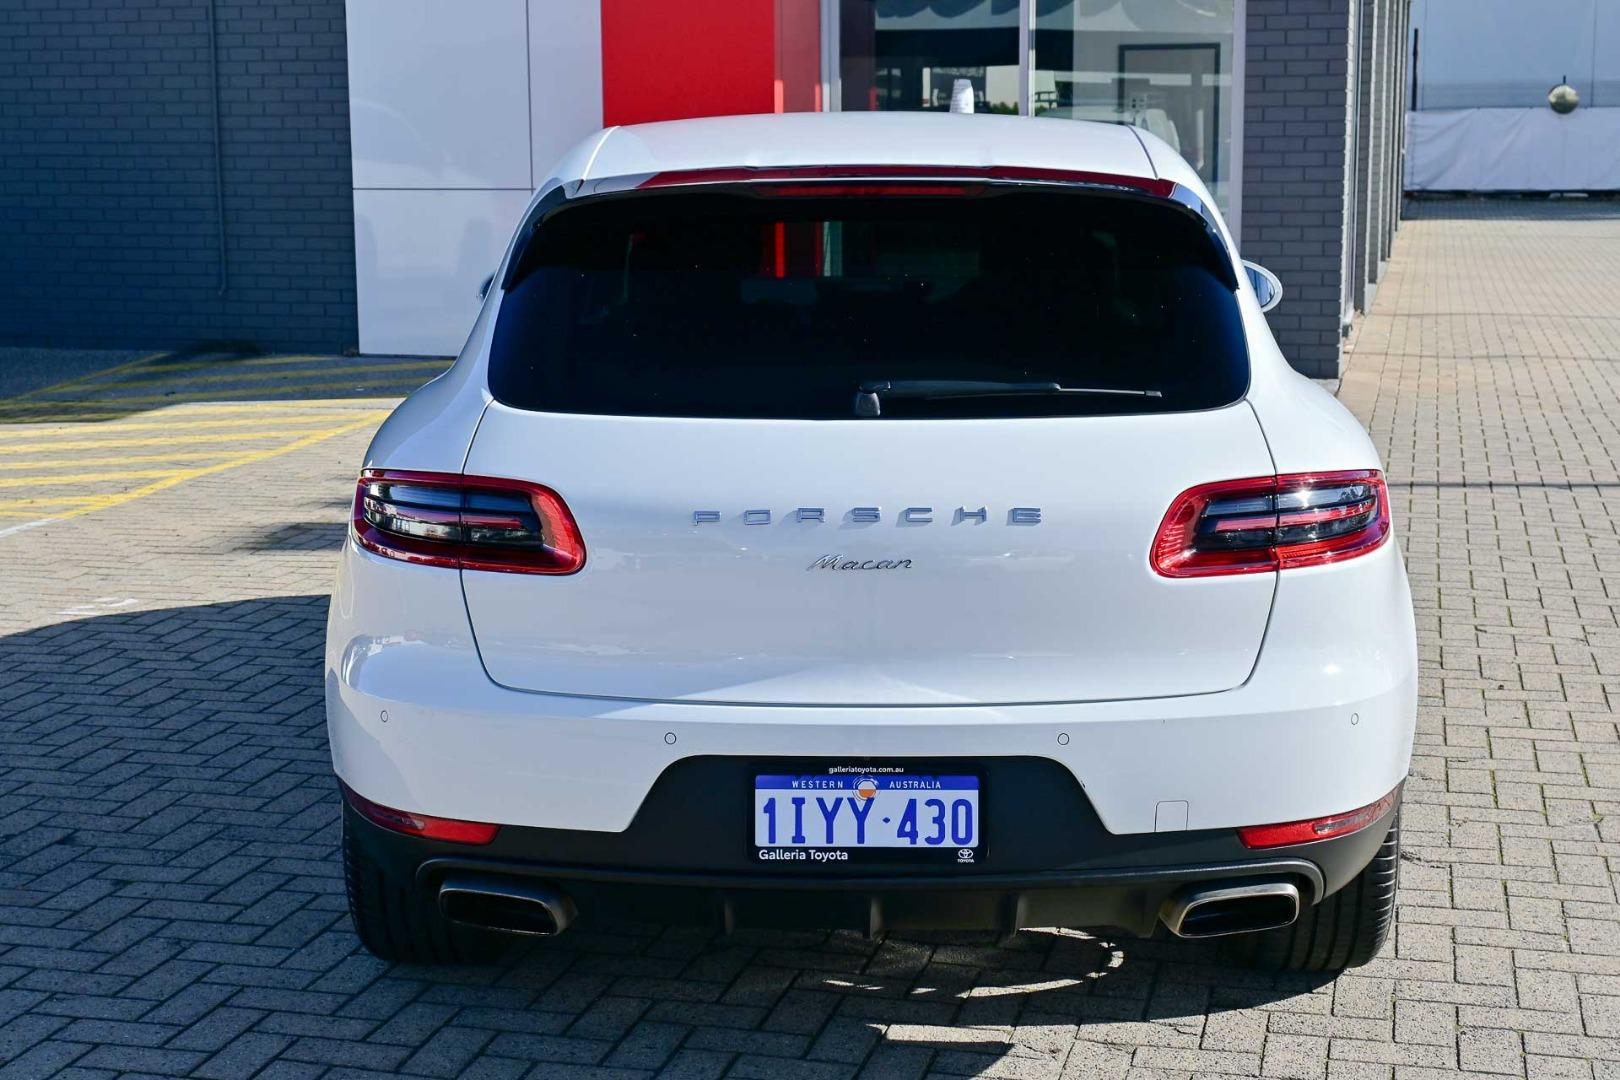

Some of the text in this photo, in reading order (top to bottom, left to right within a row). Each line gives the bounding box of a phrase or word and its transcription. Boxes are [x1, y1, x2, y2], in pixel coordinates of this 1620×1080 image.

[693, 506, 1043, 526] PORSCHE
[806, 554, 913, 571] Macan
[828, 766, 904, 774] galleriatoyota.com.au
[792, 780, 941, 789] WESTERN AUSTRALIA
[758, 849, 848, 863] Galleria Toyota
